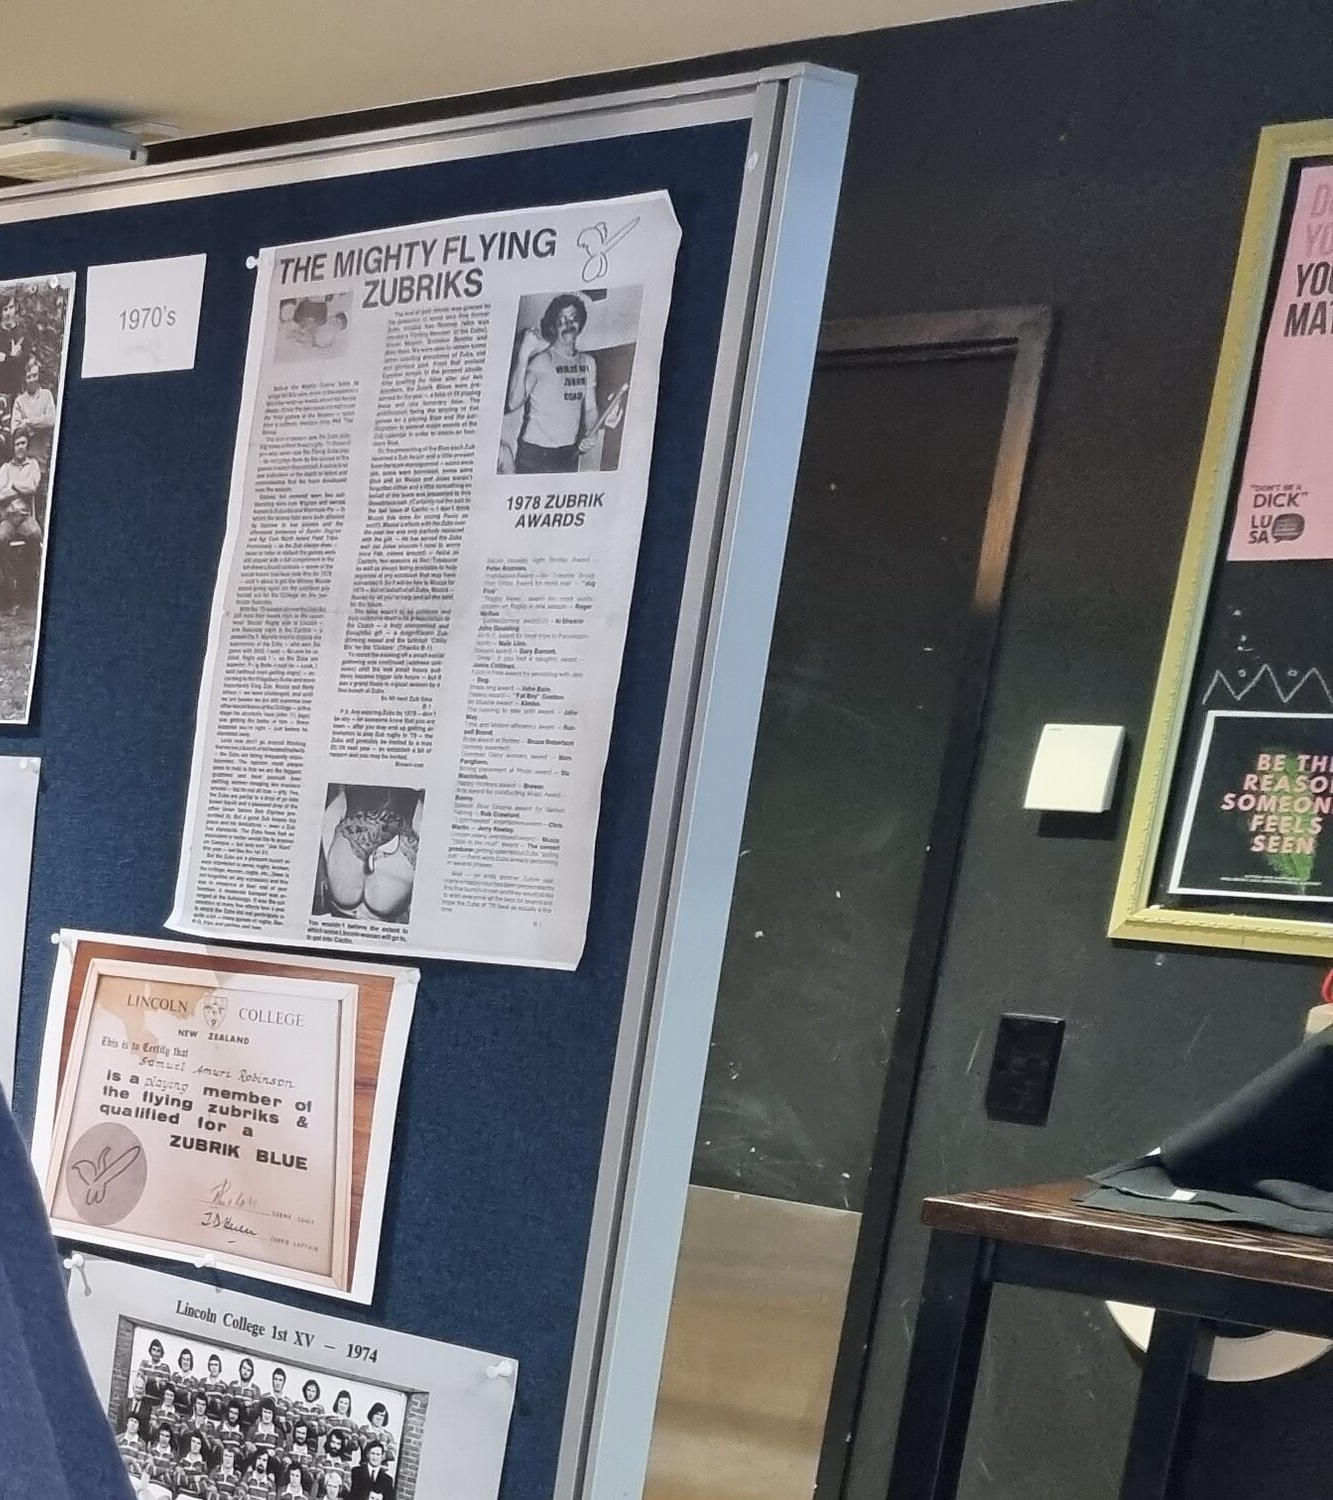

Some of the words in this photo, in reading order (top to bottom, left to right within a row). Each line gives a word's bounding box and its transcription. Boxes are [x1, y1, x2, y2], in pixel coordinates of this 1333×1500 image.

[279, 253, 326, 285] THE
[333, 240, 438, 280] MIGHTY
[442, 227, 557, 266] FLYING
[361, 267, 484, 309] ZUBRIKS
[119, 305, 177, 331] 1970's
[506, 495, 541, 511] 1978
[543, 492, 604, 510] ZUBRIK
[514, 511, 585, 529] AWARDS
[1251, 514, 1273, 529] LU
[1248, 530, 1269, 544] SA
[1257, 753, 1286, 772] BE
[1243, 773, 1333, 794] REASO
[1220, 792, 1333, 815] SOMEON
[1250, 814, 1323, 835] FEELS
[1250, 834, 1315, 855] SEEN
[126, 994, 188, 1013] LINCOLN
[238, 1007, 304, 1027] COLLEGE
[101, 1036, 118, 1048] This
[121, 1041, 129, 1049] is
[132, 1041, 140, 1051] to
[142, 1042, 170, 1057] Certify
[173, 1047, 189, 1058] that
[177, 1029, 198, 1038] NEW
[207, 1032, 250, 1045] ZEALAND
[138, 1056, 186, 1072] Samuel
[237, 1068, 296, 1089] Robinson
[129, 1074, 140, 1085] a
[203, 1086, 283, 1108] member
[294, 1100, 312, 1113] of
[102, 1085, 130, 1100] the
[142, 1090, 194, 1112] flying
[207, 1103, 280, 1125] zubriks
[296, 1115, 309, 1129] &
[99, 1103, 180, 1125] qualified
[197, 1116, 227, 1132] for
[242, 1126, 254, 1138] a
[169, 1134, 241, 1159] ZUBRIK
[255, 1149, 308, 1171] BLUE
[176, 1299, 217, 1324] Lincoln
[222, 1312, 266, 1338] College
[271, 1325, 288, 1342] 1st
[293, 1330, 316, 1349] XV
[346, 1343, 379, 1364] 1974
